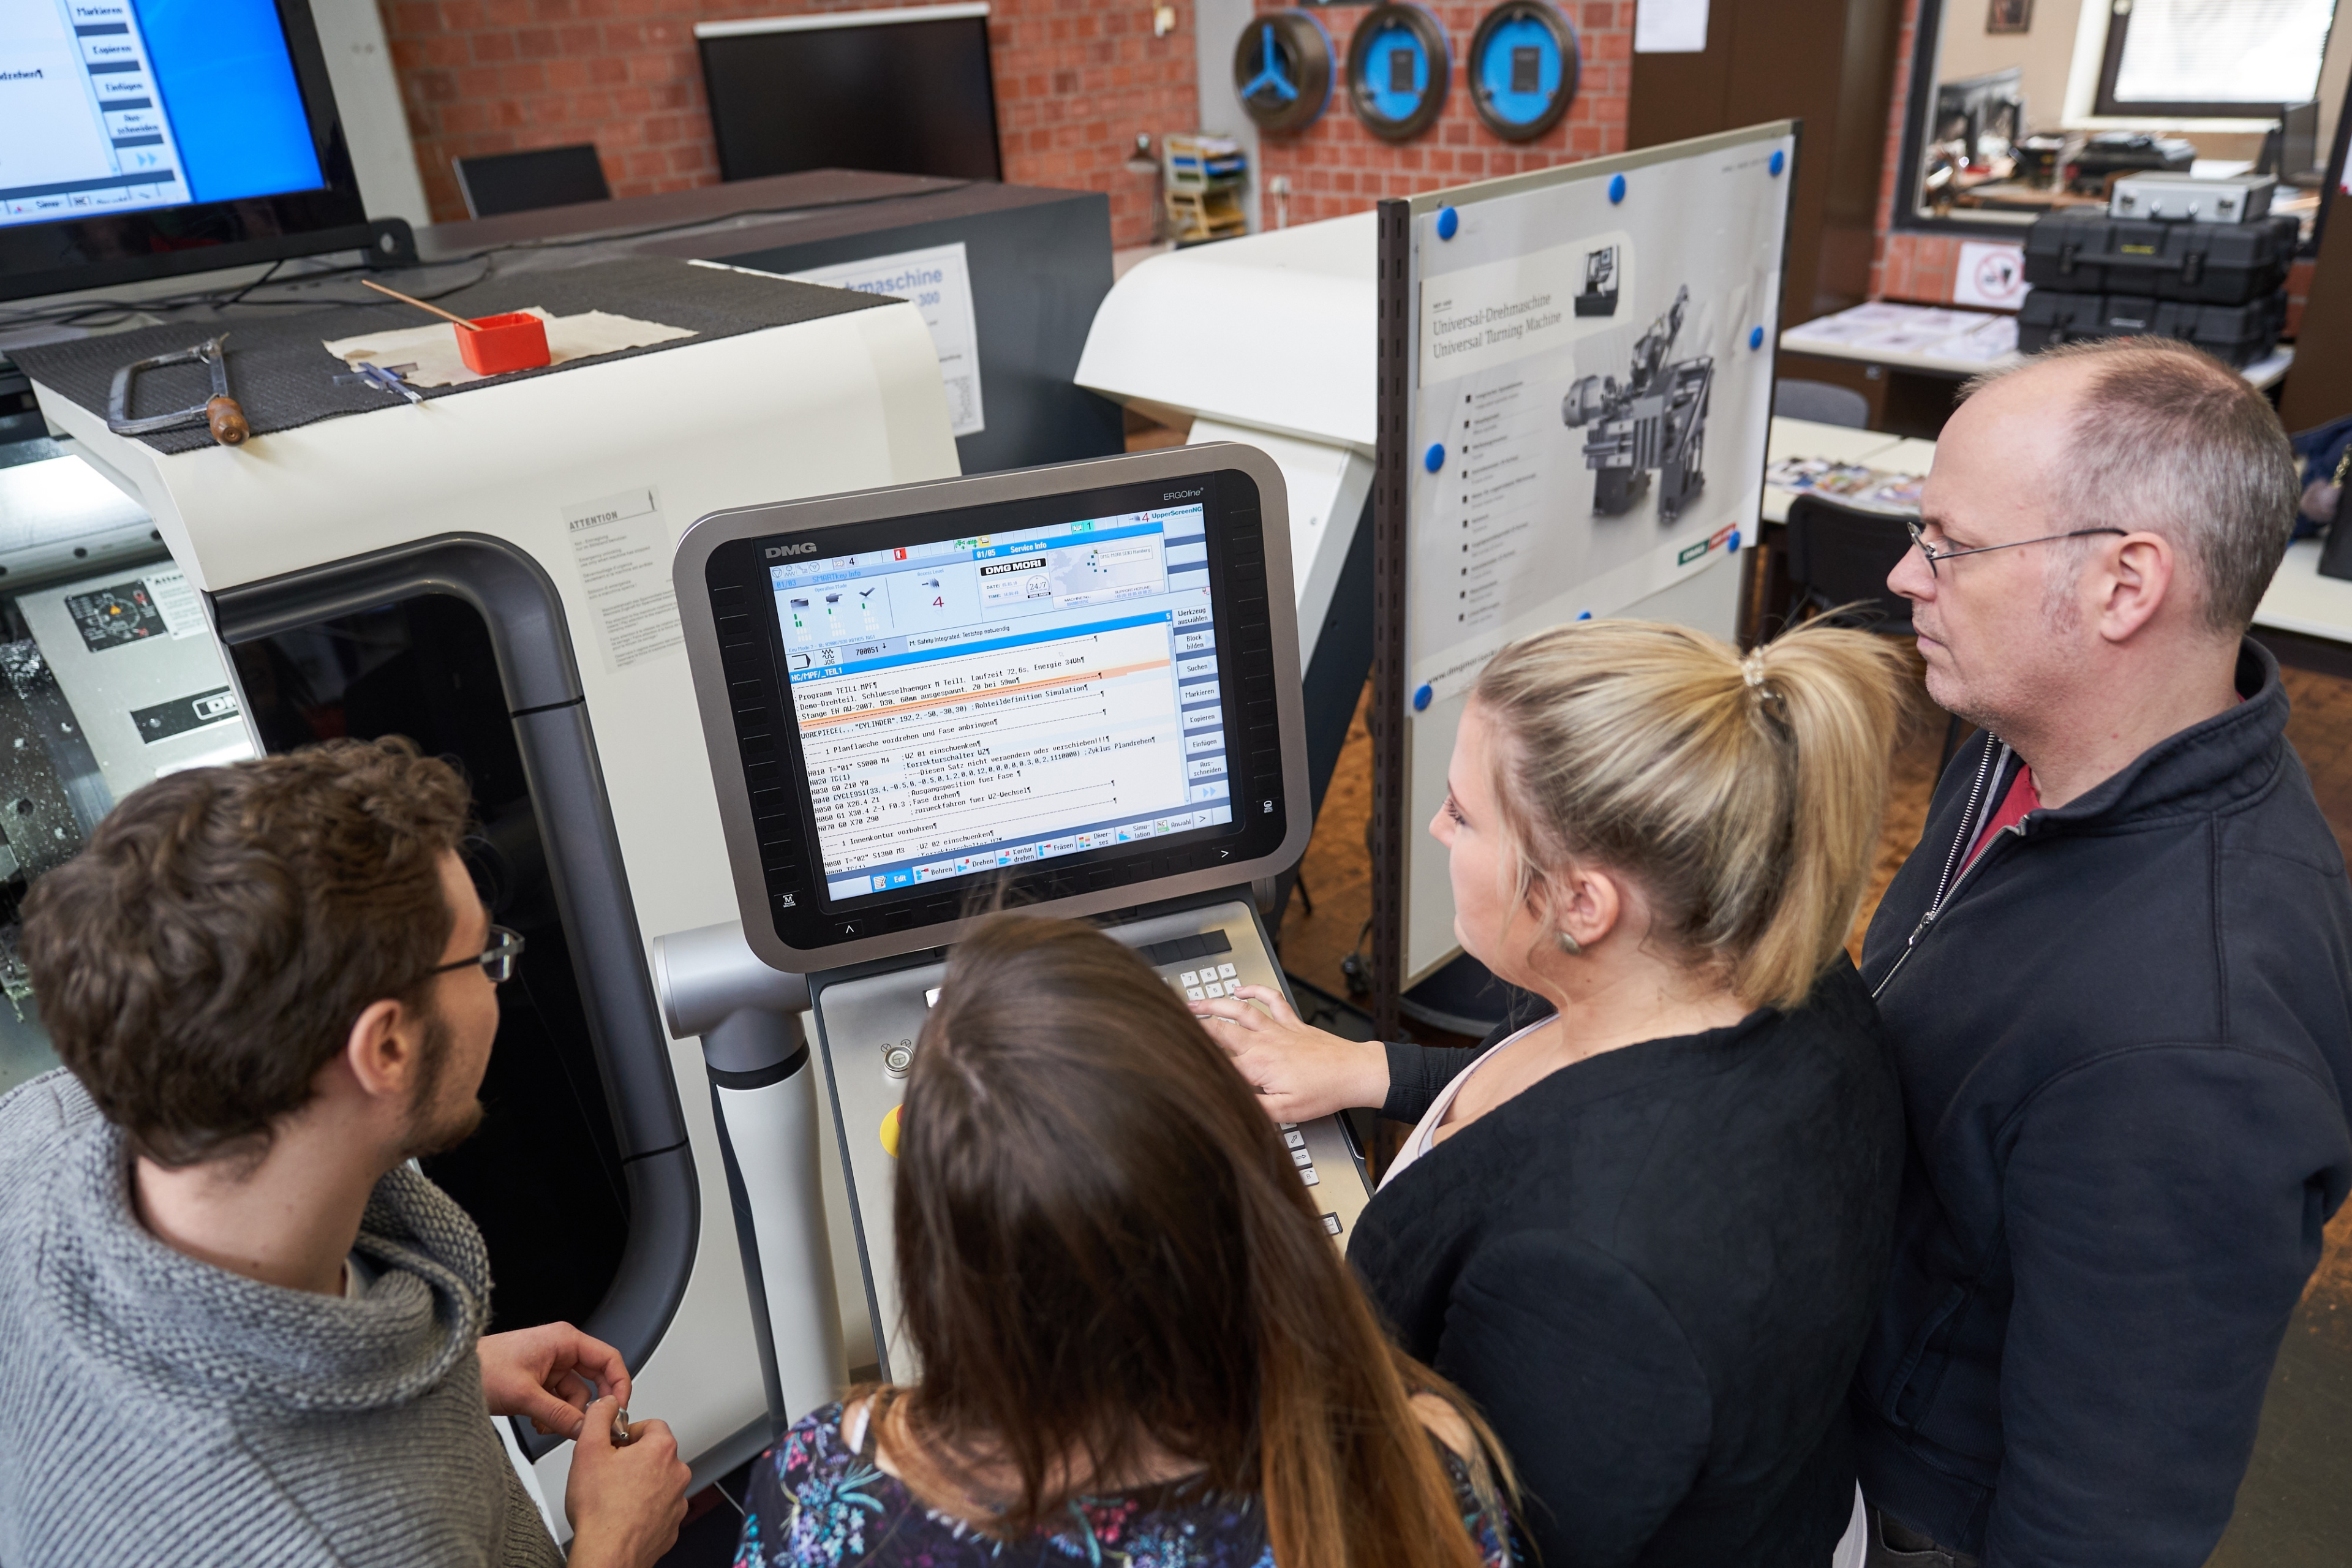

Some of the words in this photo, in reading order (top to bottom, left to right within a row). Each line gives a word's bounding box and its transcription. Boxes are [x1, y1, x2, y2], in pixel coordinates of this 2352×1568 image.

[1433, 294, 1550, 335] Universal-Drehmaschine
[1433, 334, 1482, 358] Universal
[1485, 325, 1522, 344] Turning
[1526, 312, 1560, 333] Machine
[1142, 512, 1149, 522] 4
[1151, 506, 1202, 518] UpperScreenNG
[570, 511, 618, 530] ATTENTION
[764, 542, 817, 559] DMG
[1009, 542, 1035, 554] Service
[1033, 540, 1048, 551] Info
[976, 549, 995, 559] 01/05
[848, 557, 854, 565] 4
[985, 564, 1011, 575] DMG
[1012, 559, 1041, 570] MORI
[812, 570, 848, 585] SMARTkey
[847, 568, 861, 577] Info
[776, 579, 797, 588] 01/03
[814, 584, 834, 594] Operation
[931, 596, 944, 607] 4
[1164, 612, 1171, 620] 5
[1177, 616, 1208, 625] auswählen
[916, 637, 933, 646] Safety
[933, 633, 962, 644] Integrated:
[962, 629, 983, 639] Teststop
[984, 625, 1010, 636] notwendig
[1186, 641, 1204, 649] bilden
[1186, 662, 1208, 673] Suchen
[862, 684, 930, 699] Schluesselhaenger
[971, 671, 1002, 681] Laufzeit
[921, 687, 967, 699] ausgespannt,
[1185, 689, 1214, 698] Markieren
[834, 741, 878, 753] Planflaeche
[882, 734, 919, 744] vordrehen
[808, 768, 824, 777] N010
[857, 758, 878, 767] S5000
[1193, 766, 1221, 776] schneiden
[811, 786, 828, 795] N030
[991, 752, 1030, 761] veraendern
[810, 777, 826, 786] N020
[831, 774, 850, 782] TC(1)
[813, 796, 829, 804] N040
[815, 805, 831, 813] N050
[846, 799, 867, 807] X26.4
[816, 814, 833, 823] N060
[848, 808, 869, 816] X30.4
[1133, 823, 1150, 832] Simu-
[1170, 818, 1191, 828] Anwahl
[850, 832, 892, 844] Innenkontur
[1093, 830, 1111, 840] Diver-
[1134, 829, 1150, 839] lation
[1012, 845, 1033, 856] Kontur
[1053, 840, 1074, 852] Fräsen
[971, 858, 994, 867] Drehen
[1013, 853, 1035, 863] drehen
[930, 865, 952, 875] Bohren
[894, 874, 907, 883] Edit
